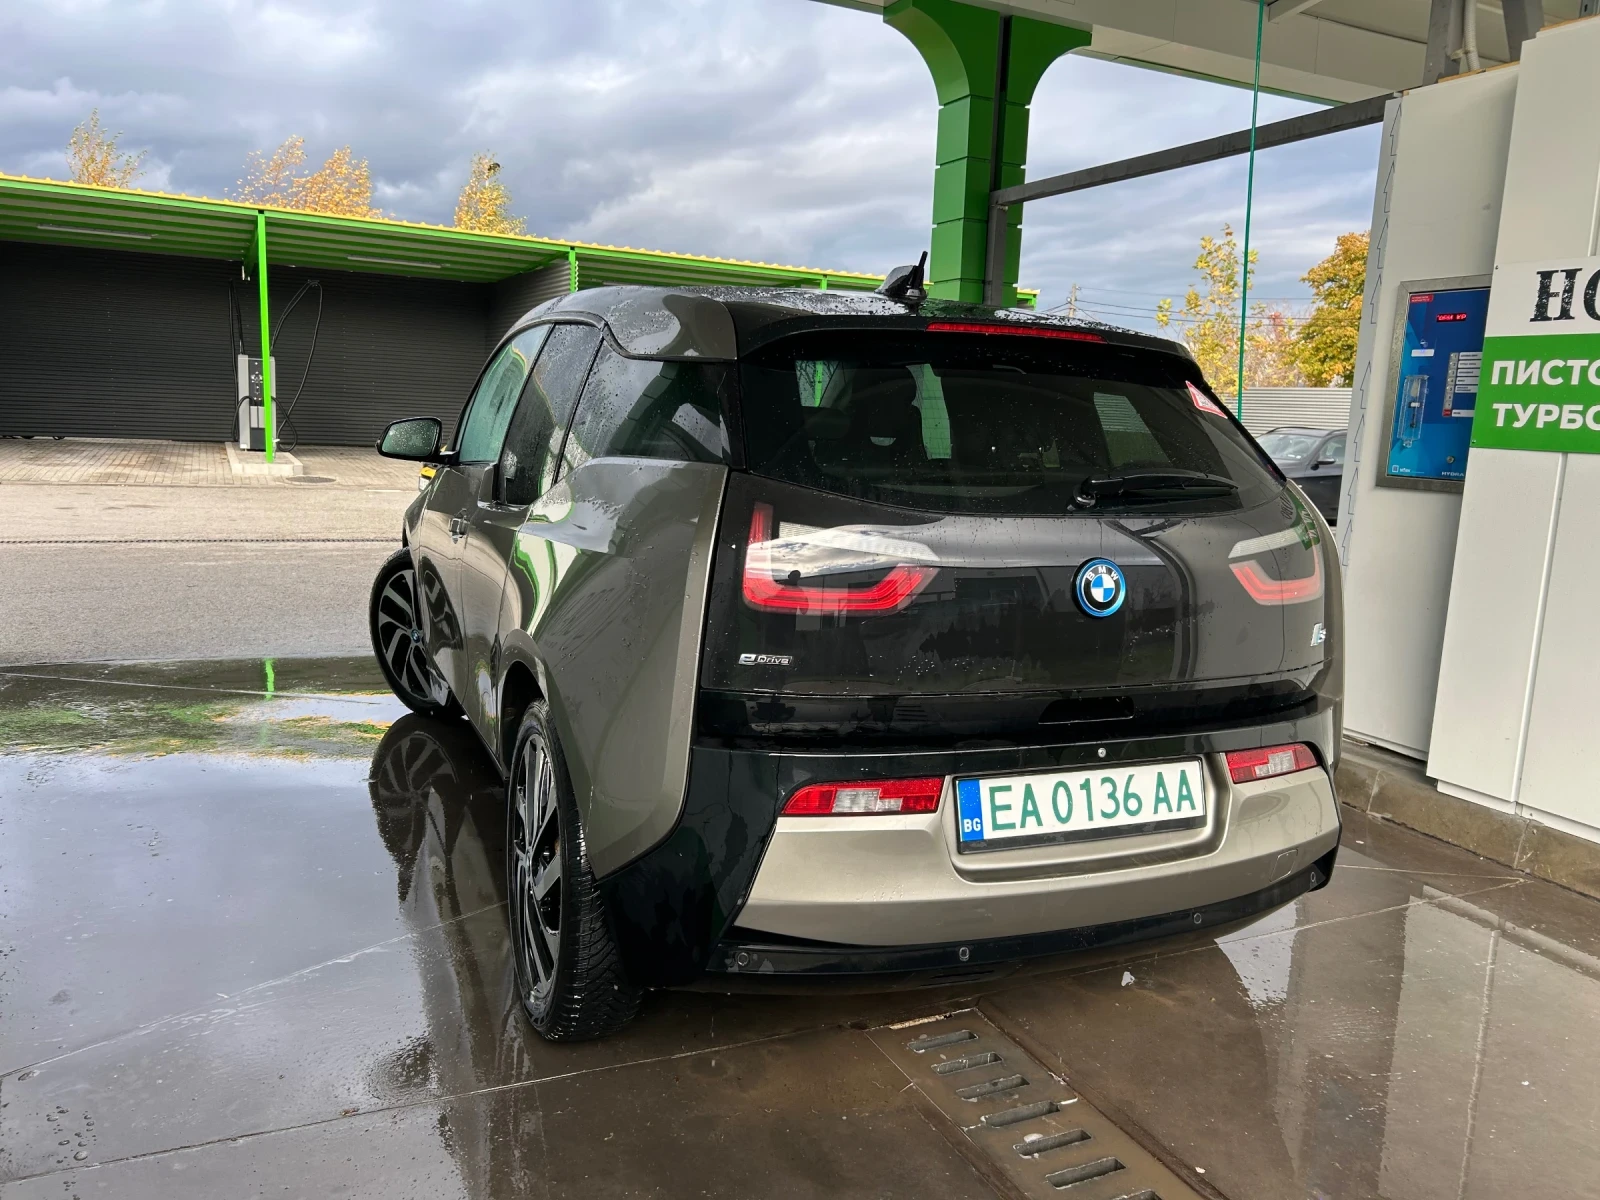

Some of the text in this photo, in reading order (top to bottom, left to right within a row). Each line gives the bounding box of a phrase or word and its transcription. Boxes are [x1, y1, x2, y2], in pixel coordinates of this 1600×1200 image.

[1086, 565, 1119, 581] BMW
[988, 769, 1196, 832] EA 0136 AA
[963, 818, 981, 833] BG
